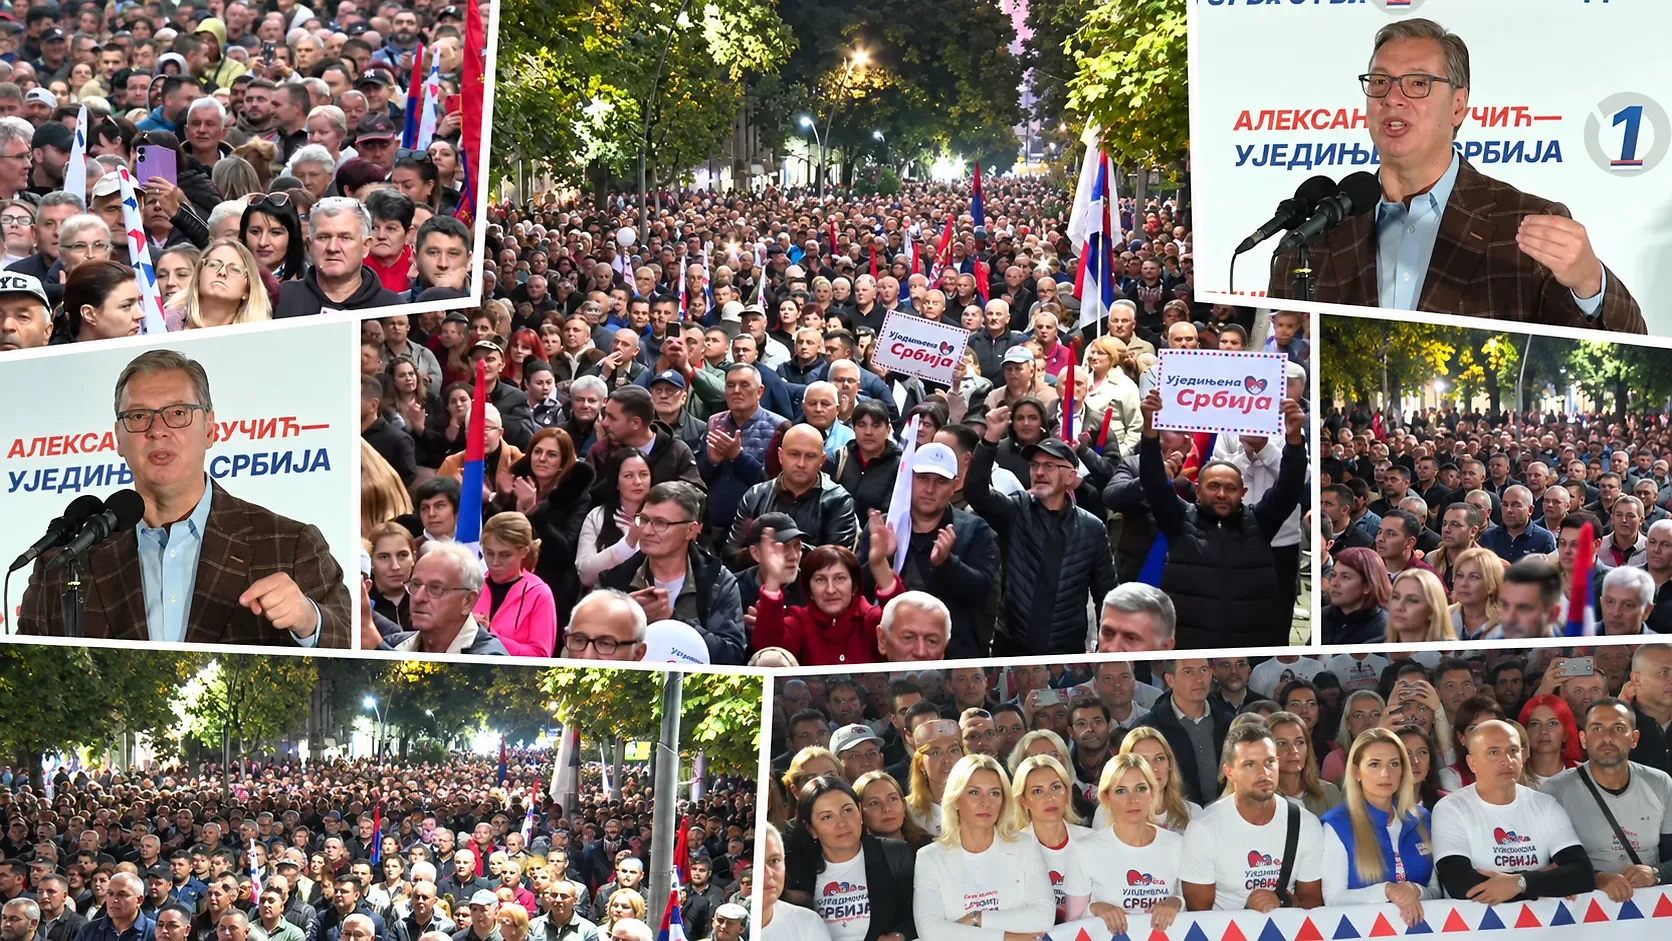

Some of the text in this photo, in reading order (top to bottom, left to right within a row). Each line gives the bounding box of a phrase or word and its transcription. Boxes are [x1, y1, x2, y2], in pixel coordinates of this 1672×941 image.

[1233, 107, 1369, 131] АЛЕКСАН
[1611, 105, 1643, 162] 1
[890, 342, 954, 368] Србија
[1166, 374, 1242, 387] Уједињена
[1176, 388, 1272, 415] Србија
[7, 431, 117, 459] АЛЕКСА
[8, 447, 331, 494] УЈЕДИЊ СРБИЈА
[1494, 853, 1539, 867] СРБИЈА
